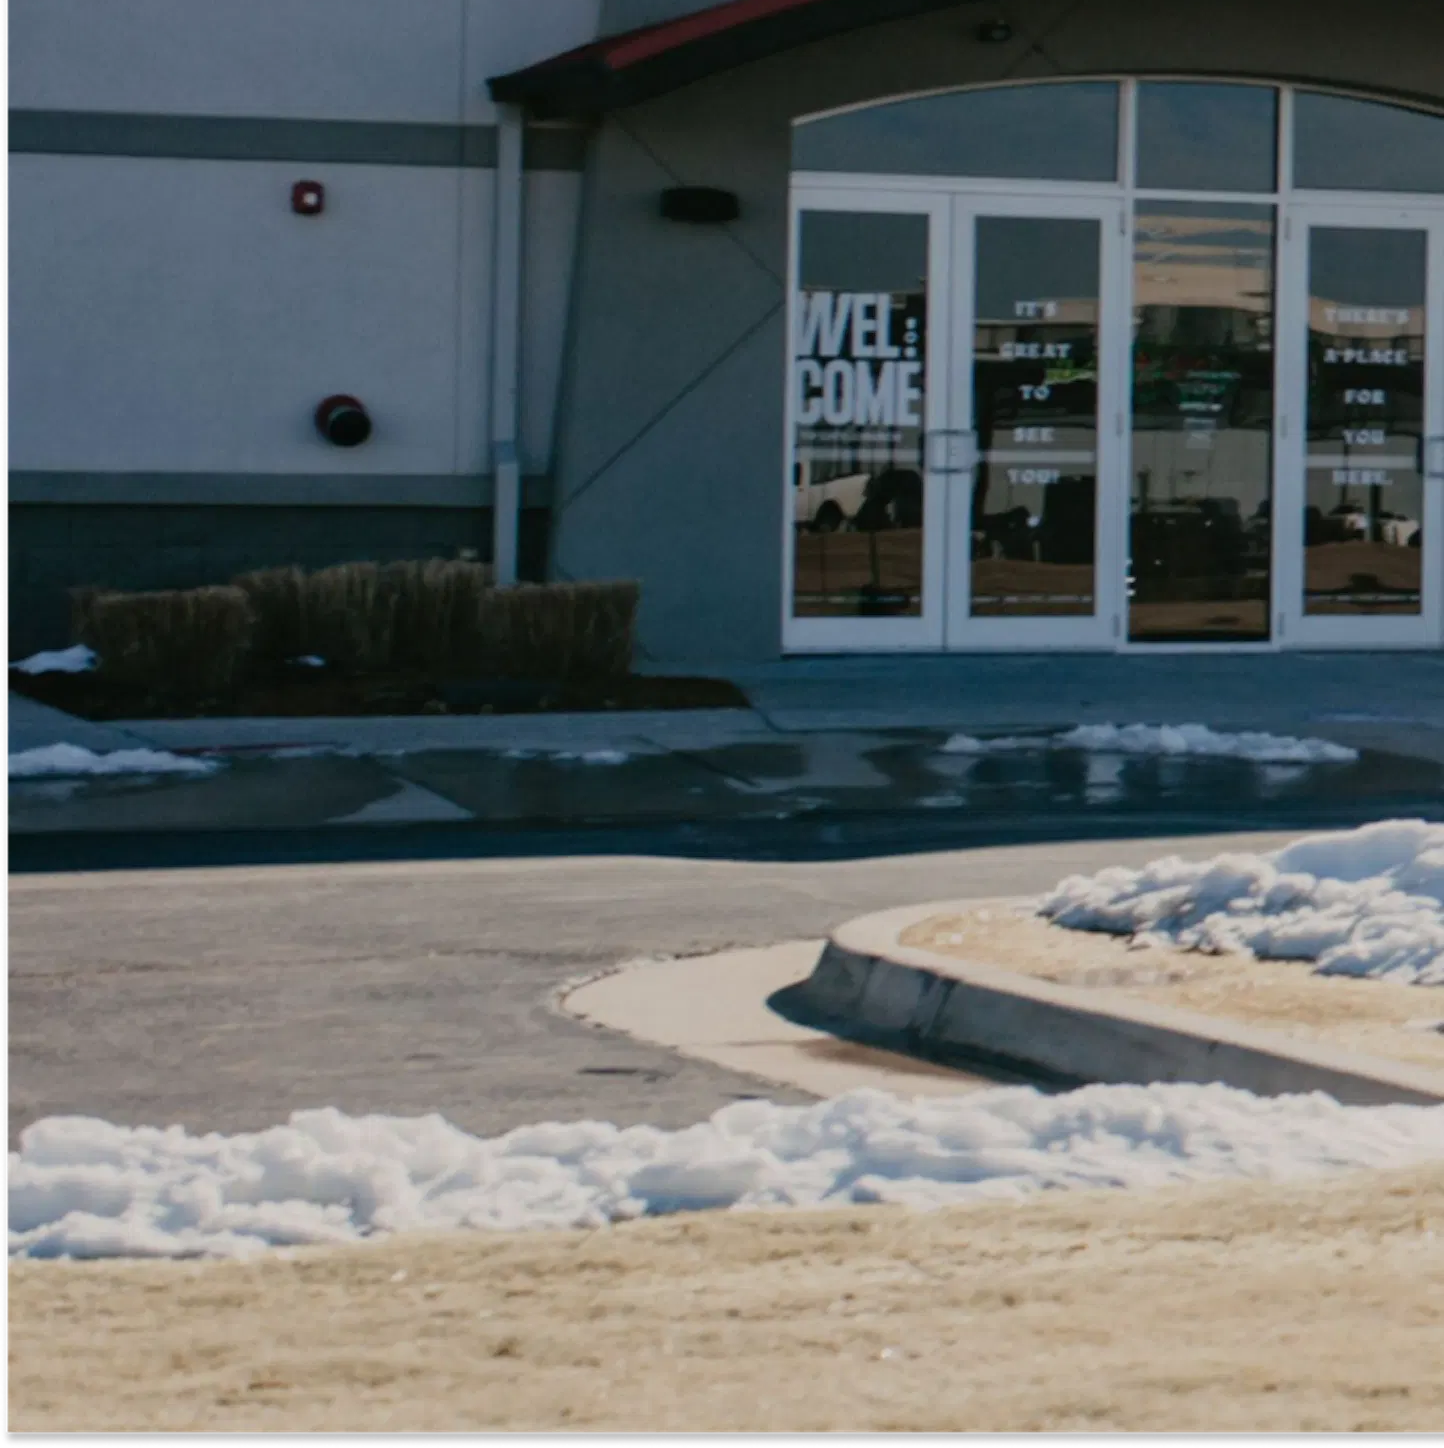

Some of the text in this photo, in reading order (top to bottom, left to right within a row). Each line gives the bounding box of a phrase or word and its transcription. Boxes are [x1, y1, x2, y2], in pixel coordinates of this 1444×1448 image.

[1001, 342, 1072, 359] GREAT
[1343, 349, 1408, 366] PLACE
[794, 359, 922, 427] COME
[1018, 383, 1051, 401] TO
[1344, 388, 1385, 406] FOR
[1013, 427, 1054, 443] SEE
[1342, 428, 1385, 445] YOU
